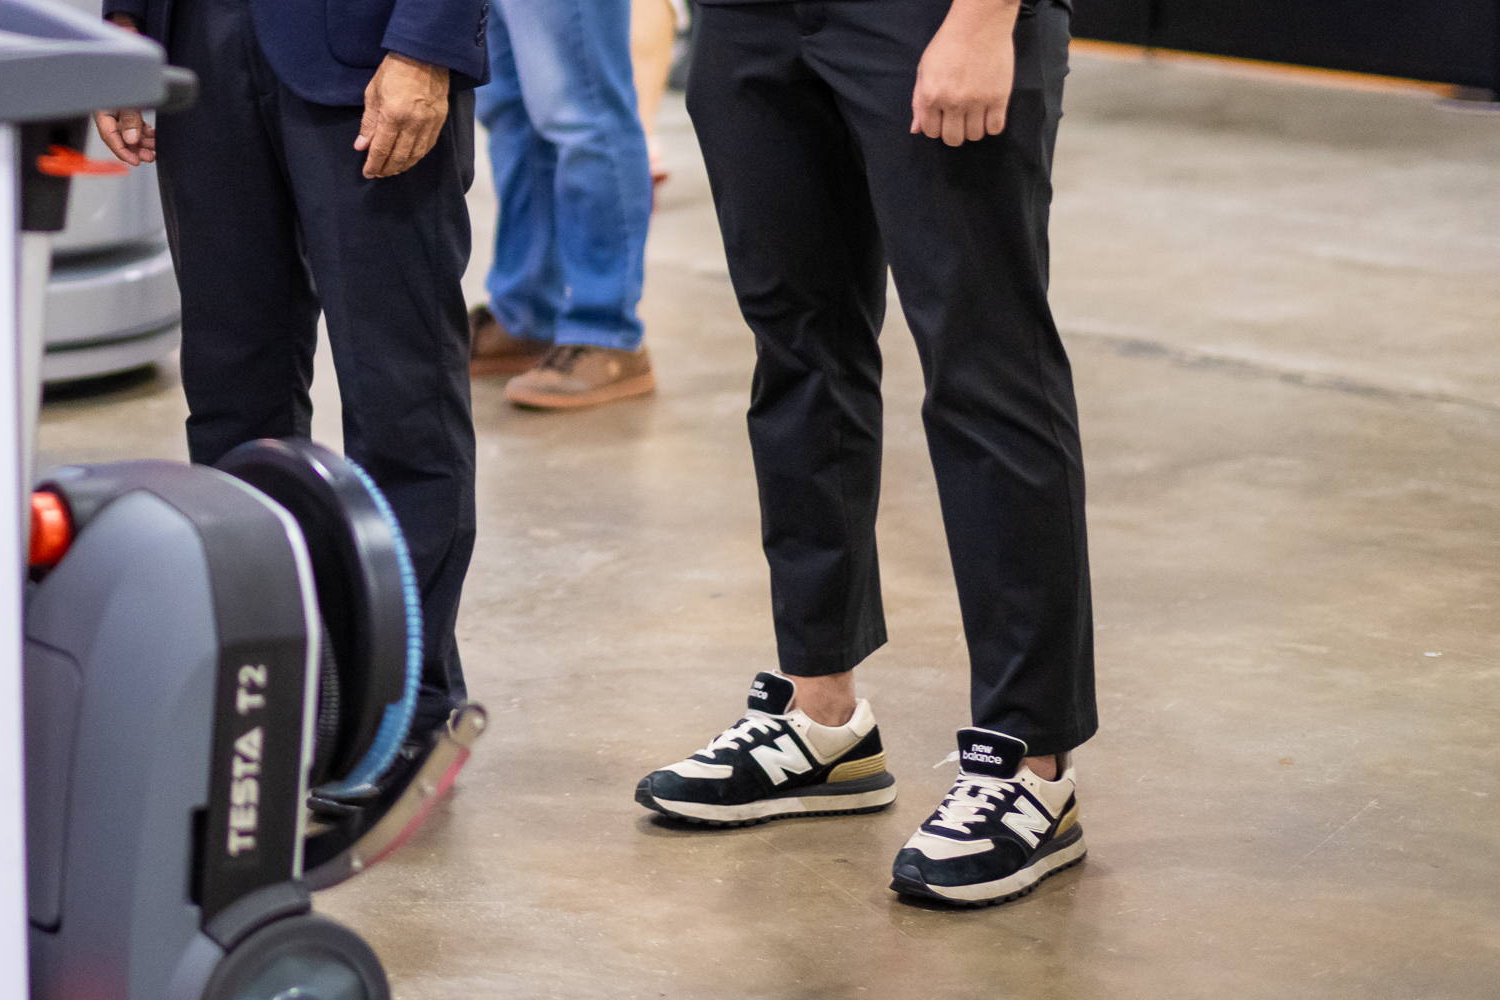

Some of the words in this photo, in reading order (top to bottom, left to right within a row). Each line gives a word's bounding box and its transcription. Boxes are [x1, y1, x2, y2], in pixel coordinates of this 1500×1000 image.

[236, 664, 268, 716] T2
[963, 750, 1002, 764] balance
[972, 744, 993, 754] new
[227, 726, 264, 857] TESTA
